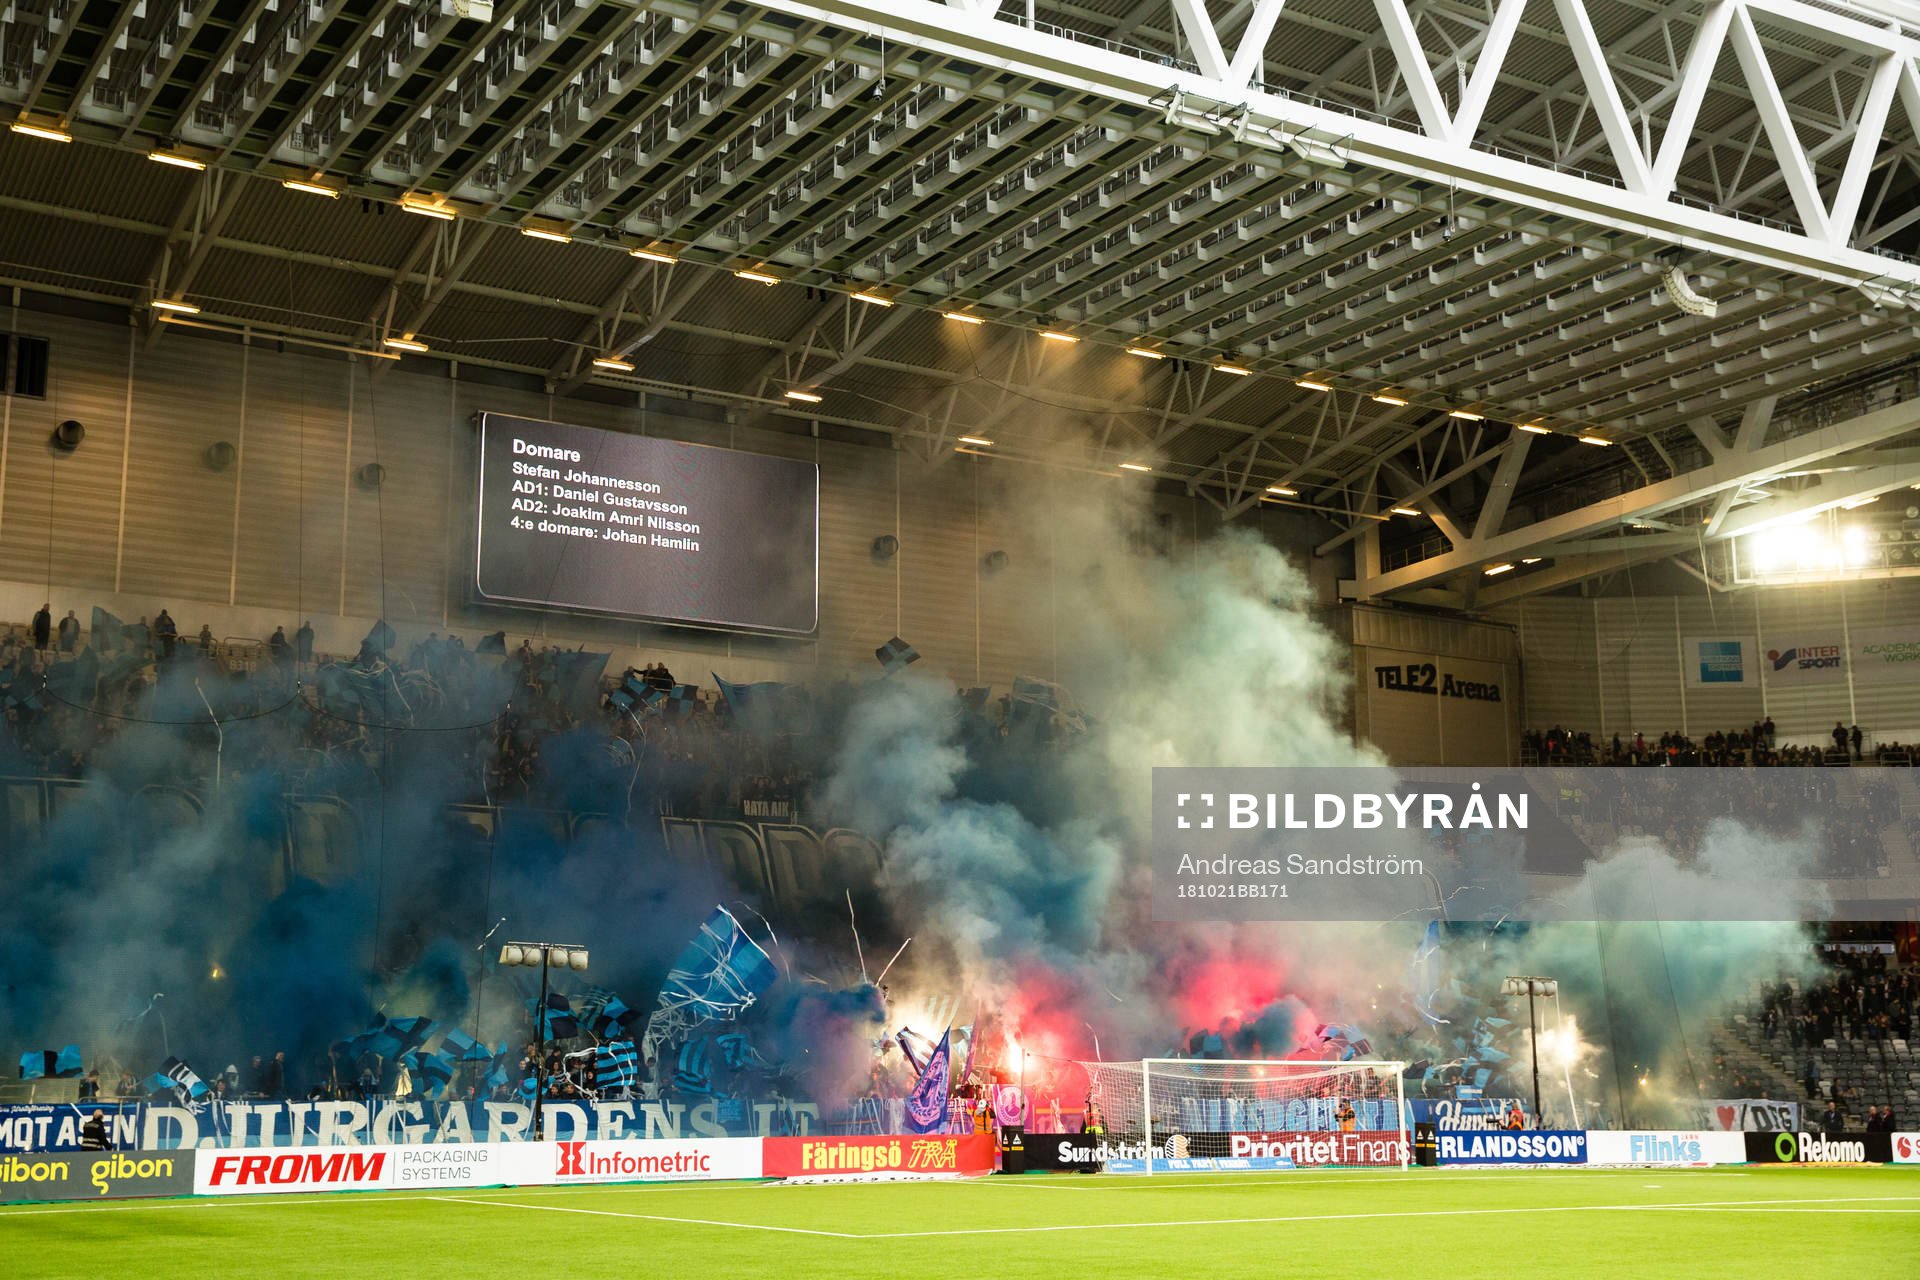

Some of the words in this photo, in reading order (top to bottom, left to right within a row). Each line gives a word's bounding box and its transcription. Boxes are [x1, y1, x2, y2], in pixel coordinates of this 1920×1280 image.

[513, 438, 581, 463] Domare
[512, 462, 560, 480] Stefan
[564, 469, 661, 495] Johannesson
[512, 480, 549, 497] AD1:
[553, 484, 599, 503] Daniel
[603, 493, 688, 515] Gustavsson
[512, 498, 548, 515] AD2:
[552, 503, 605, 522] Joakim
[609, 511, 643, 527] Amri
[647, 516, 700, 534] Nilsson
[510, 516, 534, 531] 4:e
[538, 520, 599, 539] domare:
[602, 528, 647, 545] Johan
[651, 534, 700, 551] Hamlin
[1798, 646, 1839, 658] INTER
[1799, 657, 1840, 670] SPORT
[1375, 663, 1438, 695] TELE2
[1441, 673, 1502, 702] Arena
[403, 1150, 488, 1165] PACKAGING
[590, 1150, 710, 1175] Infometric
[802, 1141, 902, 1171] Färingsö
[908, 1139, 957, 1169] TRÄ
[1058, 1141, 1165, 1163] Sundström
[1231, 1135, 1341, 1166] Prioritet
[1631, 1135, 1701, 1161] Flinks
[1798, 1133, 1865, 1163] Rekomo
[91, 1157, 173, 1195] gibon
[209, 1153, 387, 1186] FROMM
[402, 1167, 472, 1181] SYSTEMS
